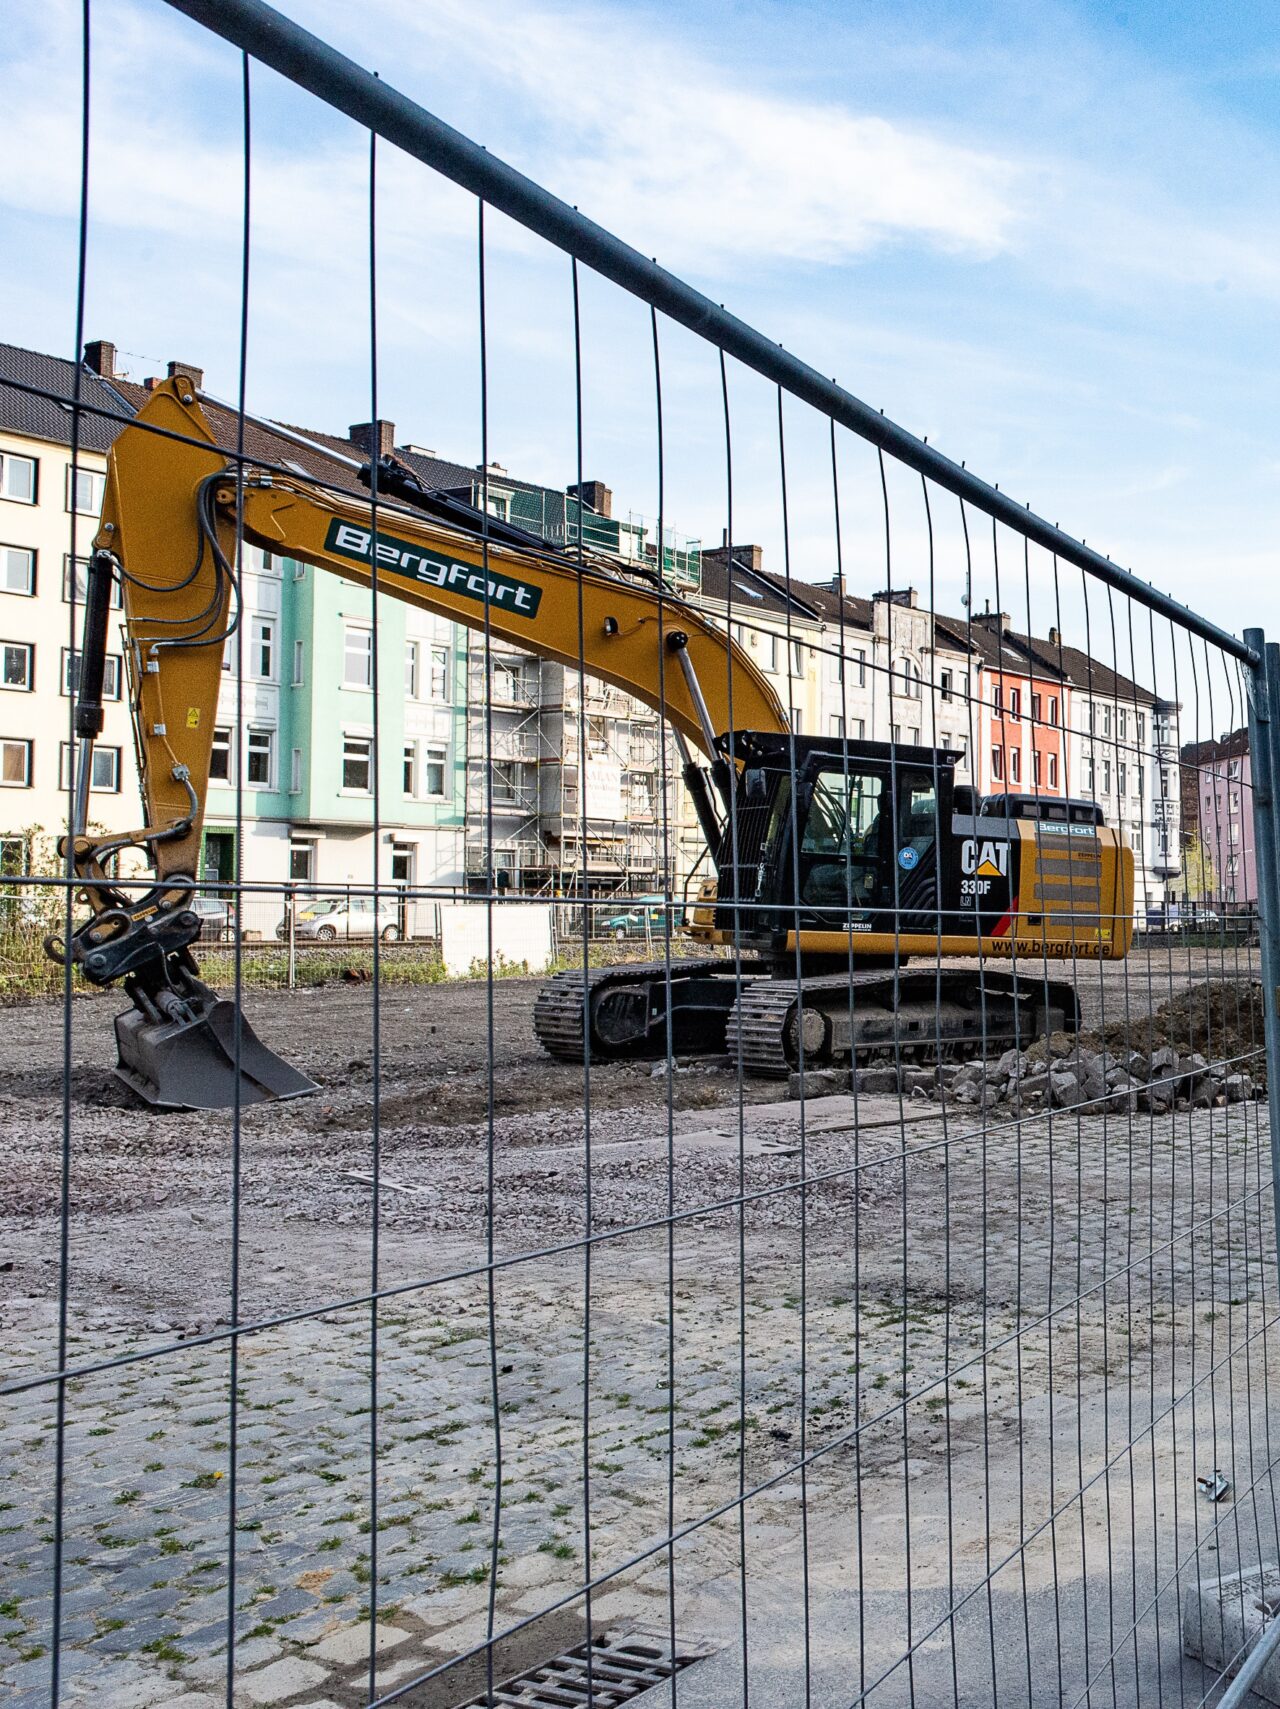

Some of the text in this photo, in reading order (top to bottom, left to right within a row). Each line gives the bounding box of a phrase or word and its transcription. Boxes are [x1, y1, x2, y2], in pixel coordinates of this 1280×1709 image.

[335, 524, 532, 610] Bergfort
[1038, 823, 1095, 835] Bergfort
[961, 839, 1011, 876] CAT
[961, 880, 991, 894] 330F
[992, 940, 1110, 956] www.bergfort.de
